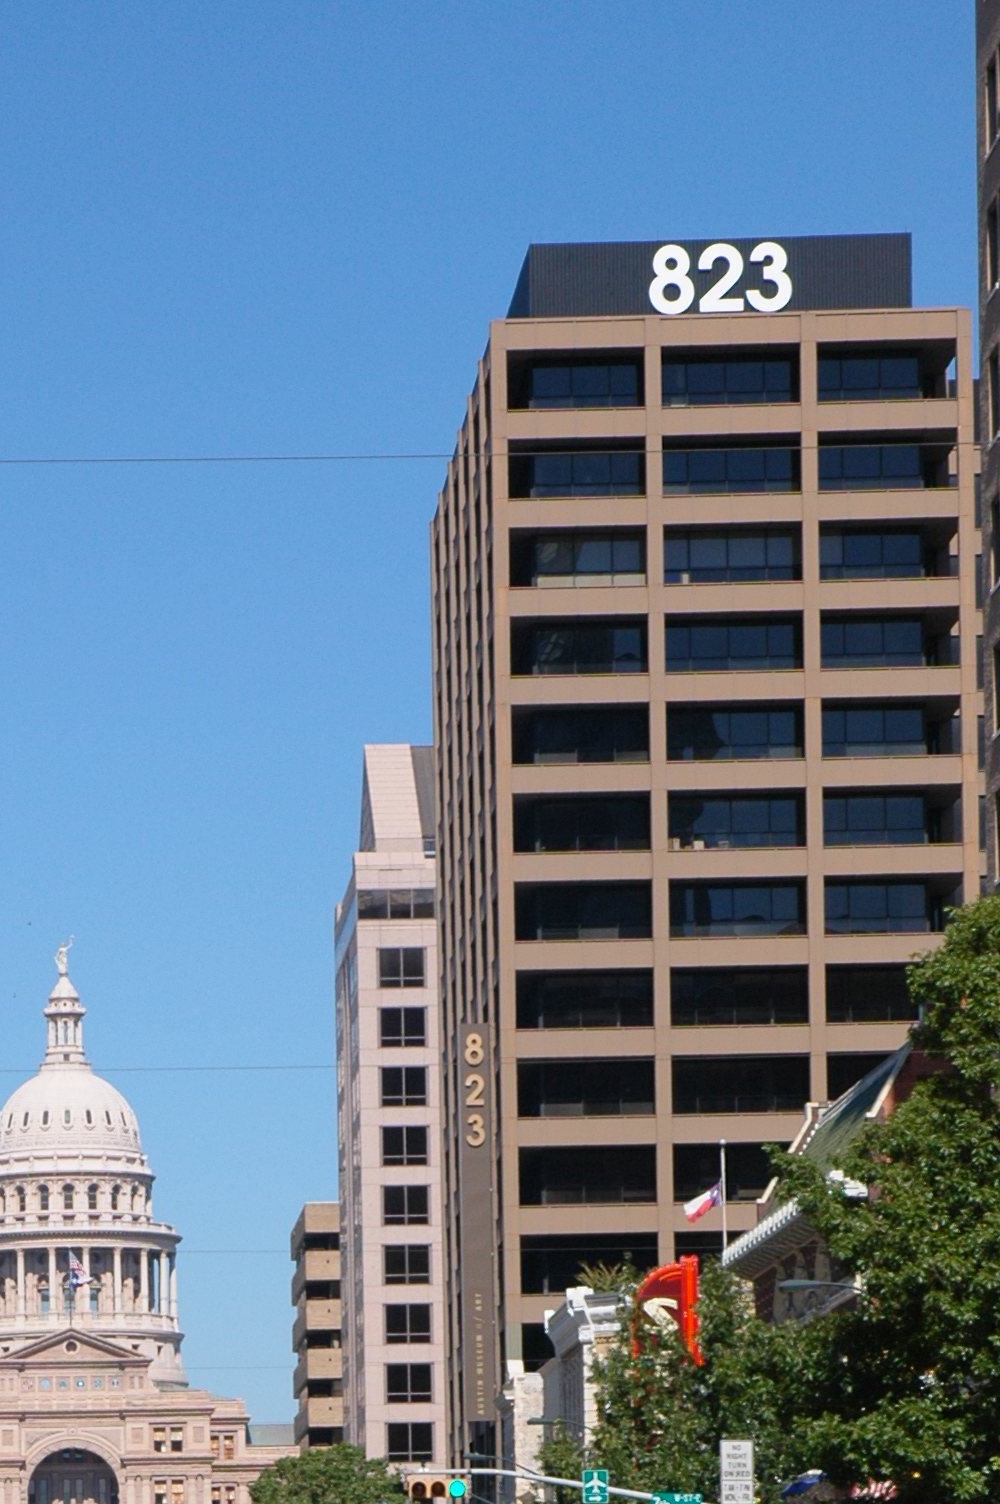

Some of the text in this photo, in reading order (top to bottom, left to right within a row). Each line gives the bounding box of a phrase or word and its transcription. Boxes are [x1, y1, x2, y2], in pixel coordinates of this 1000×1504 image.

[649, 242, 793, 315] 823
[465, 1033, 486, 1147] 823
[475, 1334, 484, 1375] MUSEUM
[477, 1380, 485, 1415] AUSTIN
[735, 1470, 750, 1478] RED
